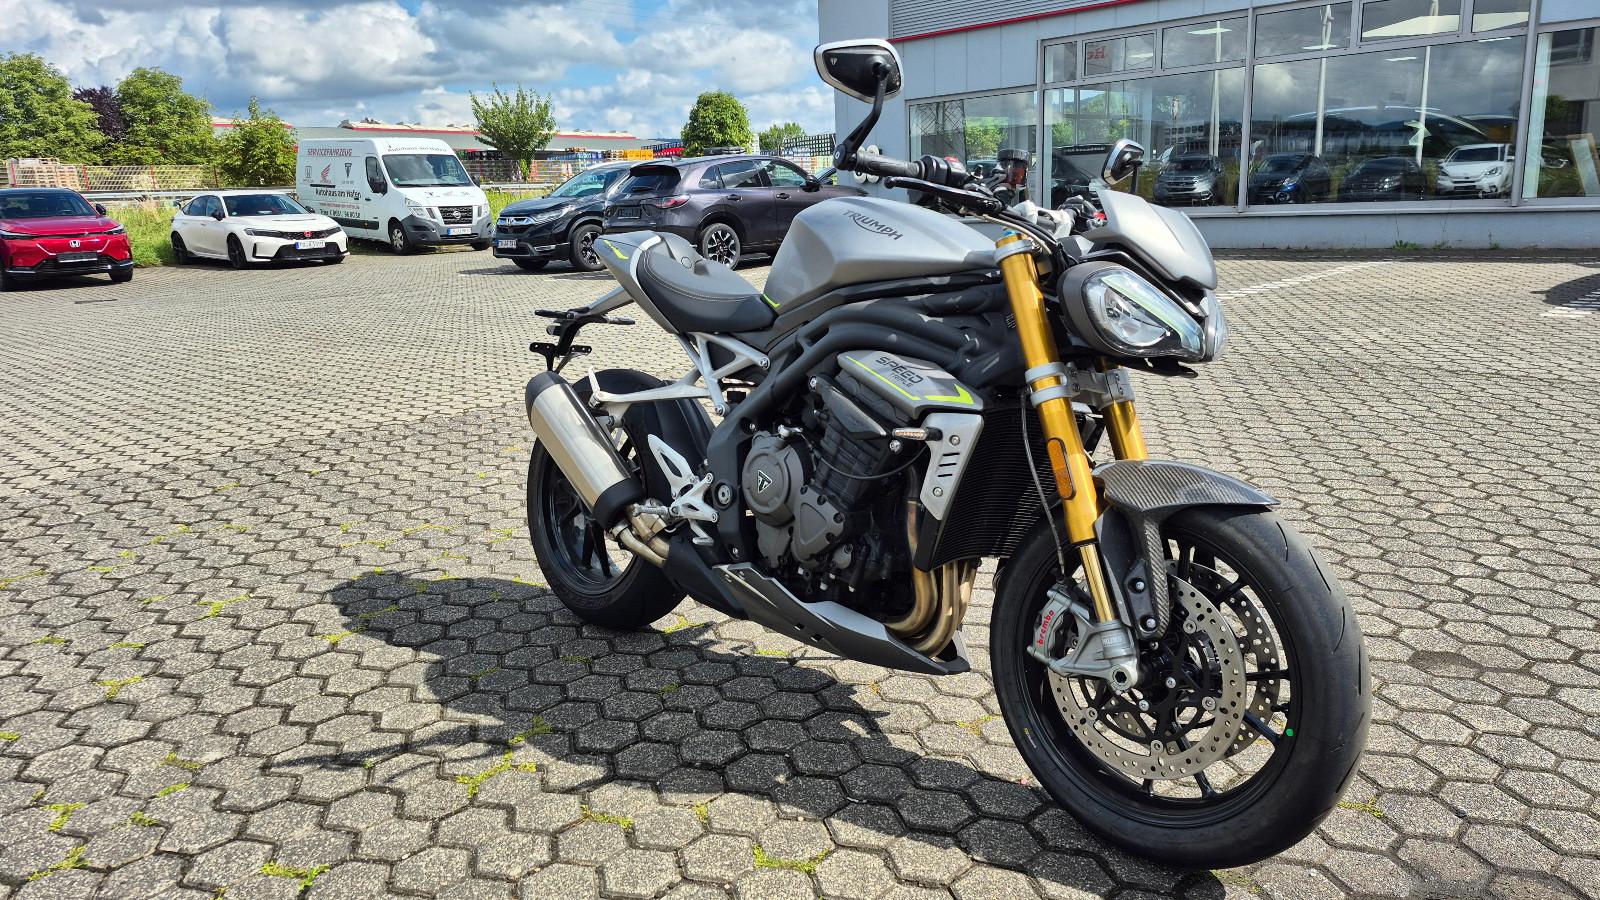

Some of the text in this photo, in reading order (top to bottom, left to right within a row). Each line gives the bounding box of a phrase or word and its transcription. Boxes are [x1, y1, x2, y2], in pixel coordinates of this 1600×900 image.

[842, 210, 903, 240] TRIUMPH
[876, 356, 924, 383] SPEED
[1036, 610, 1055, 645] brembo
